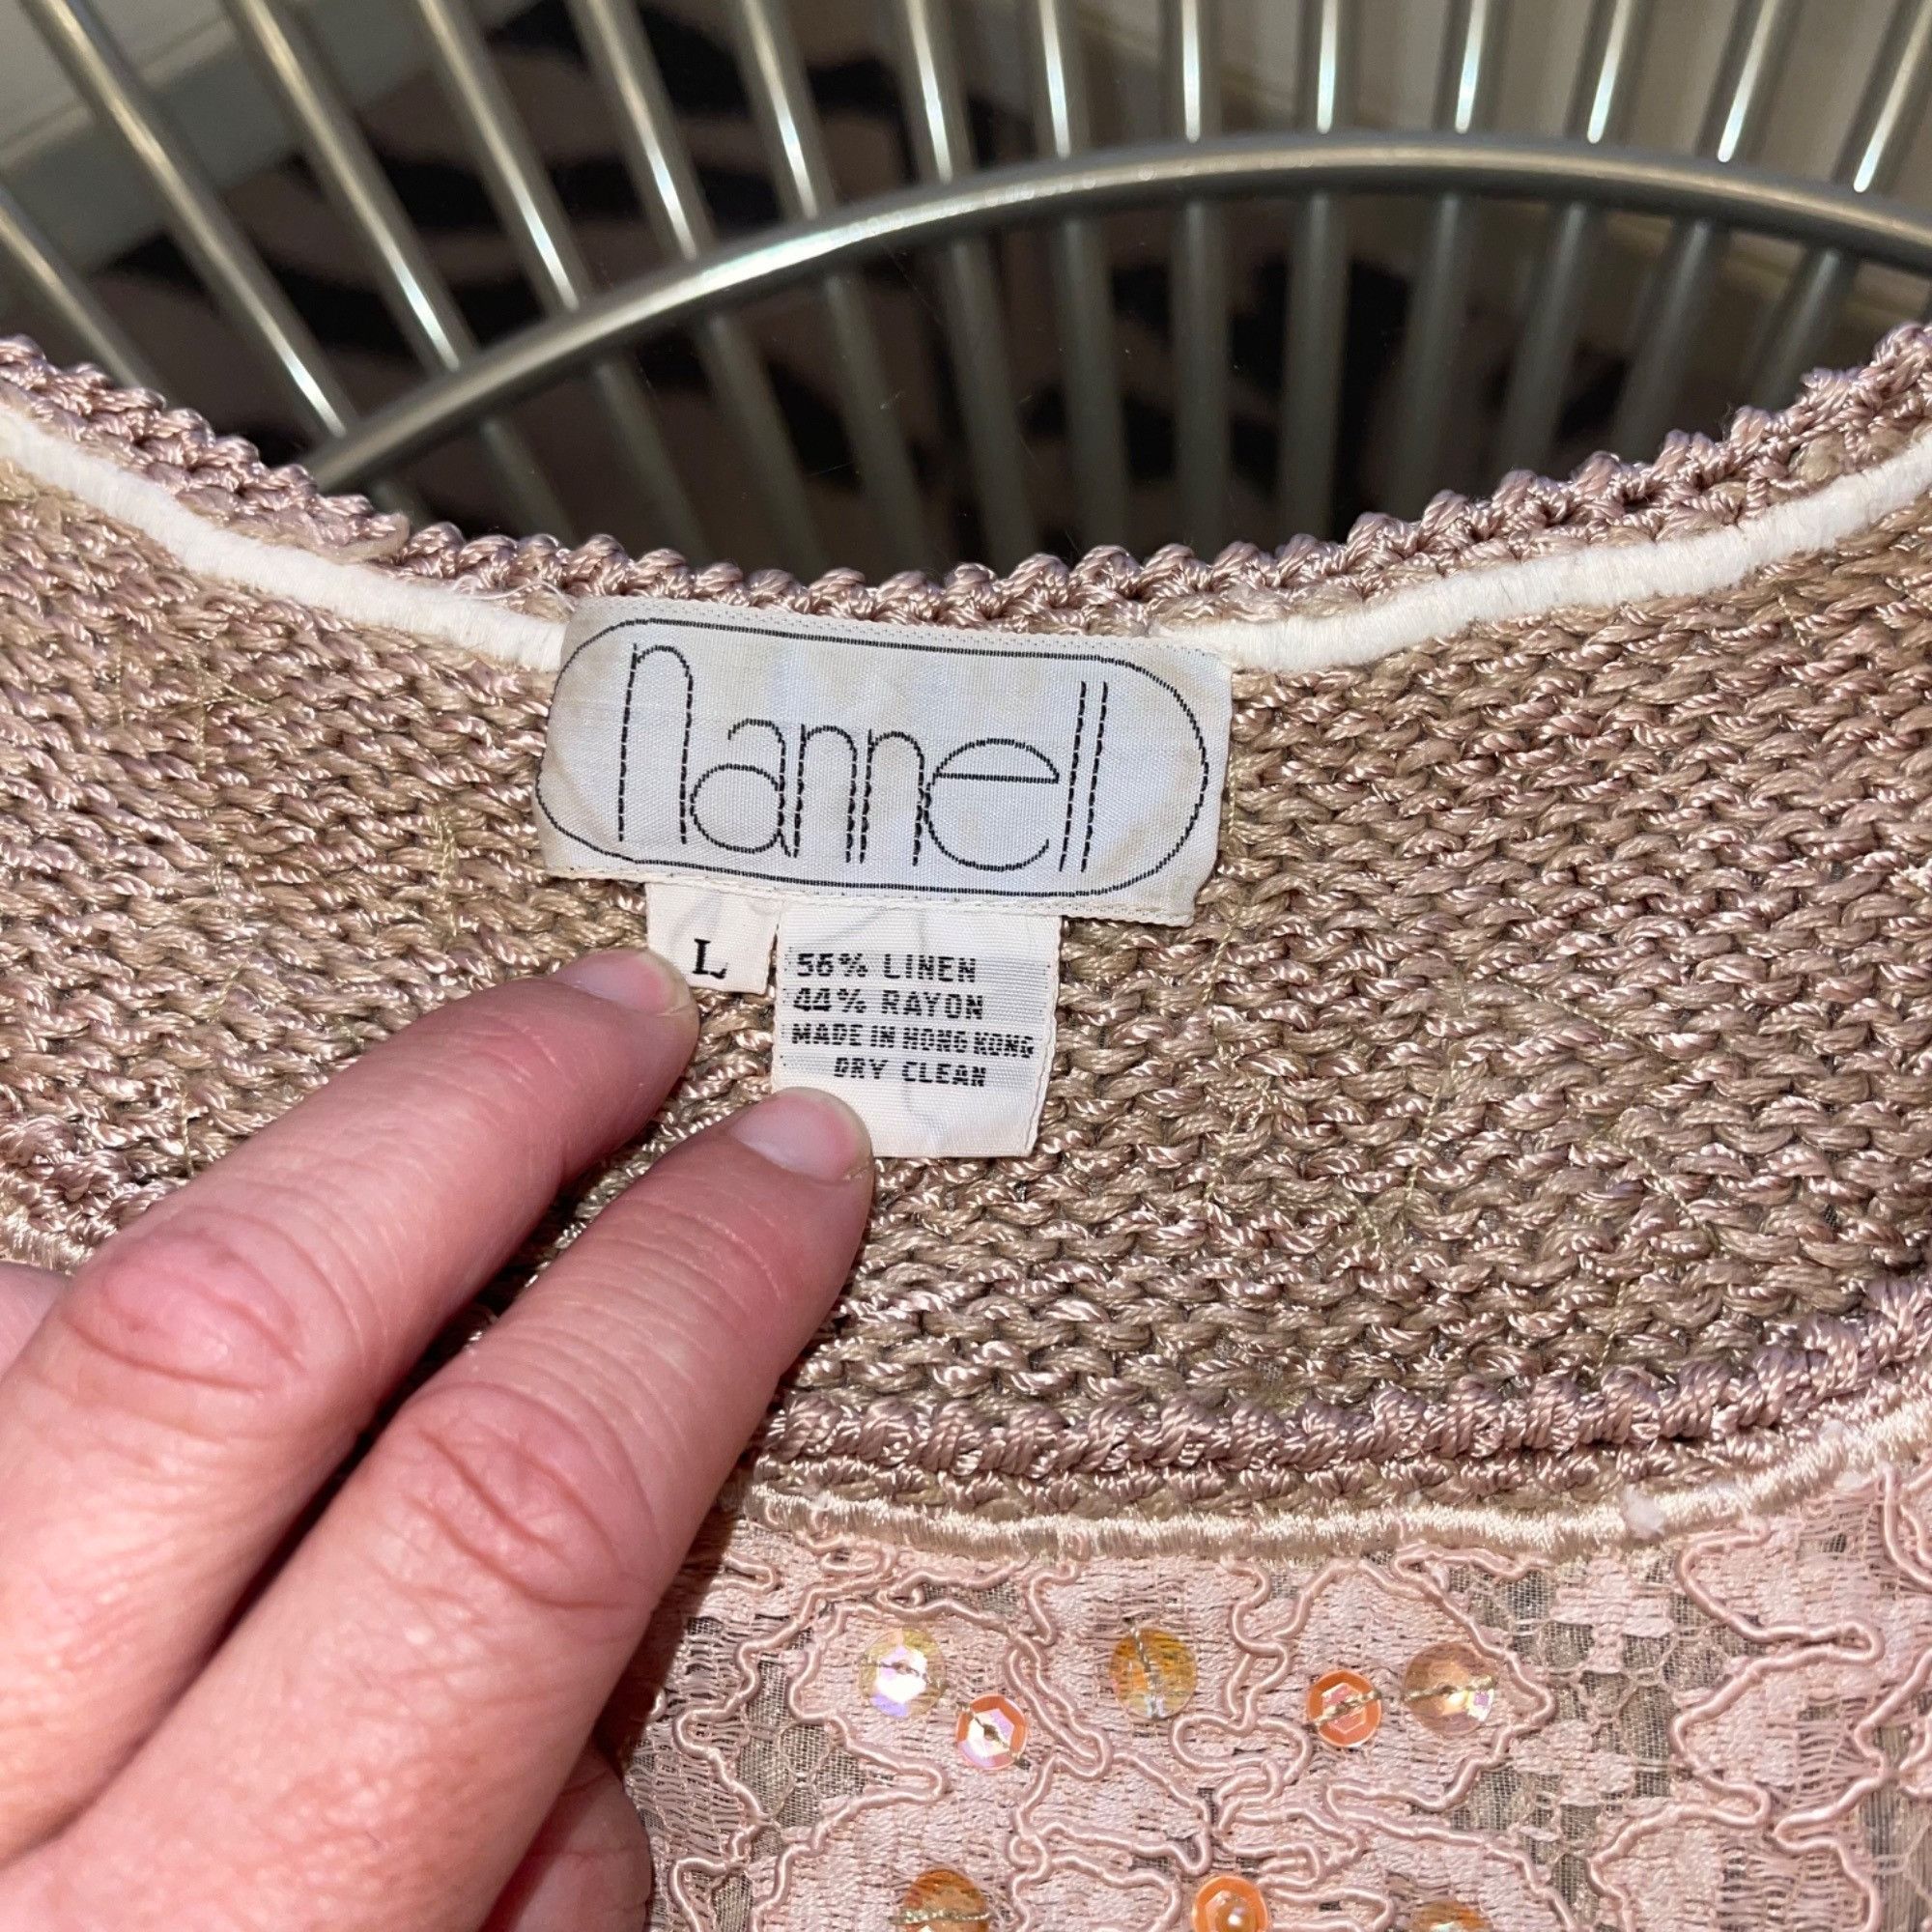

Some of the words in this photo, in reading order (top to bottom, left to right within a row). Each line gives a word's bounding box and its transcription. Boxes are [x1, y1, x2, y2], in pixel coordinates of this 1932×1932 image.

[692, 938, 728, 980] L
[796, 952, 868, 980] 56%
[881, 952, 977, 983] LINEN
[792, 986, 867, 1014] 44%
[880, 991, 984, 1020] RAYON
[791, 1023, 863, 1046] MADE
[869, 1025, 895, 1049] IN
[901, 1027, 968, 1054] HONG
[973, 1031, 1035, 1059] KONG
[834, 1057, 889, 1080] DRY
[901, 1061, 987, 1088] CLEAN
